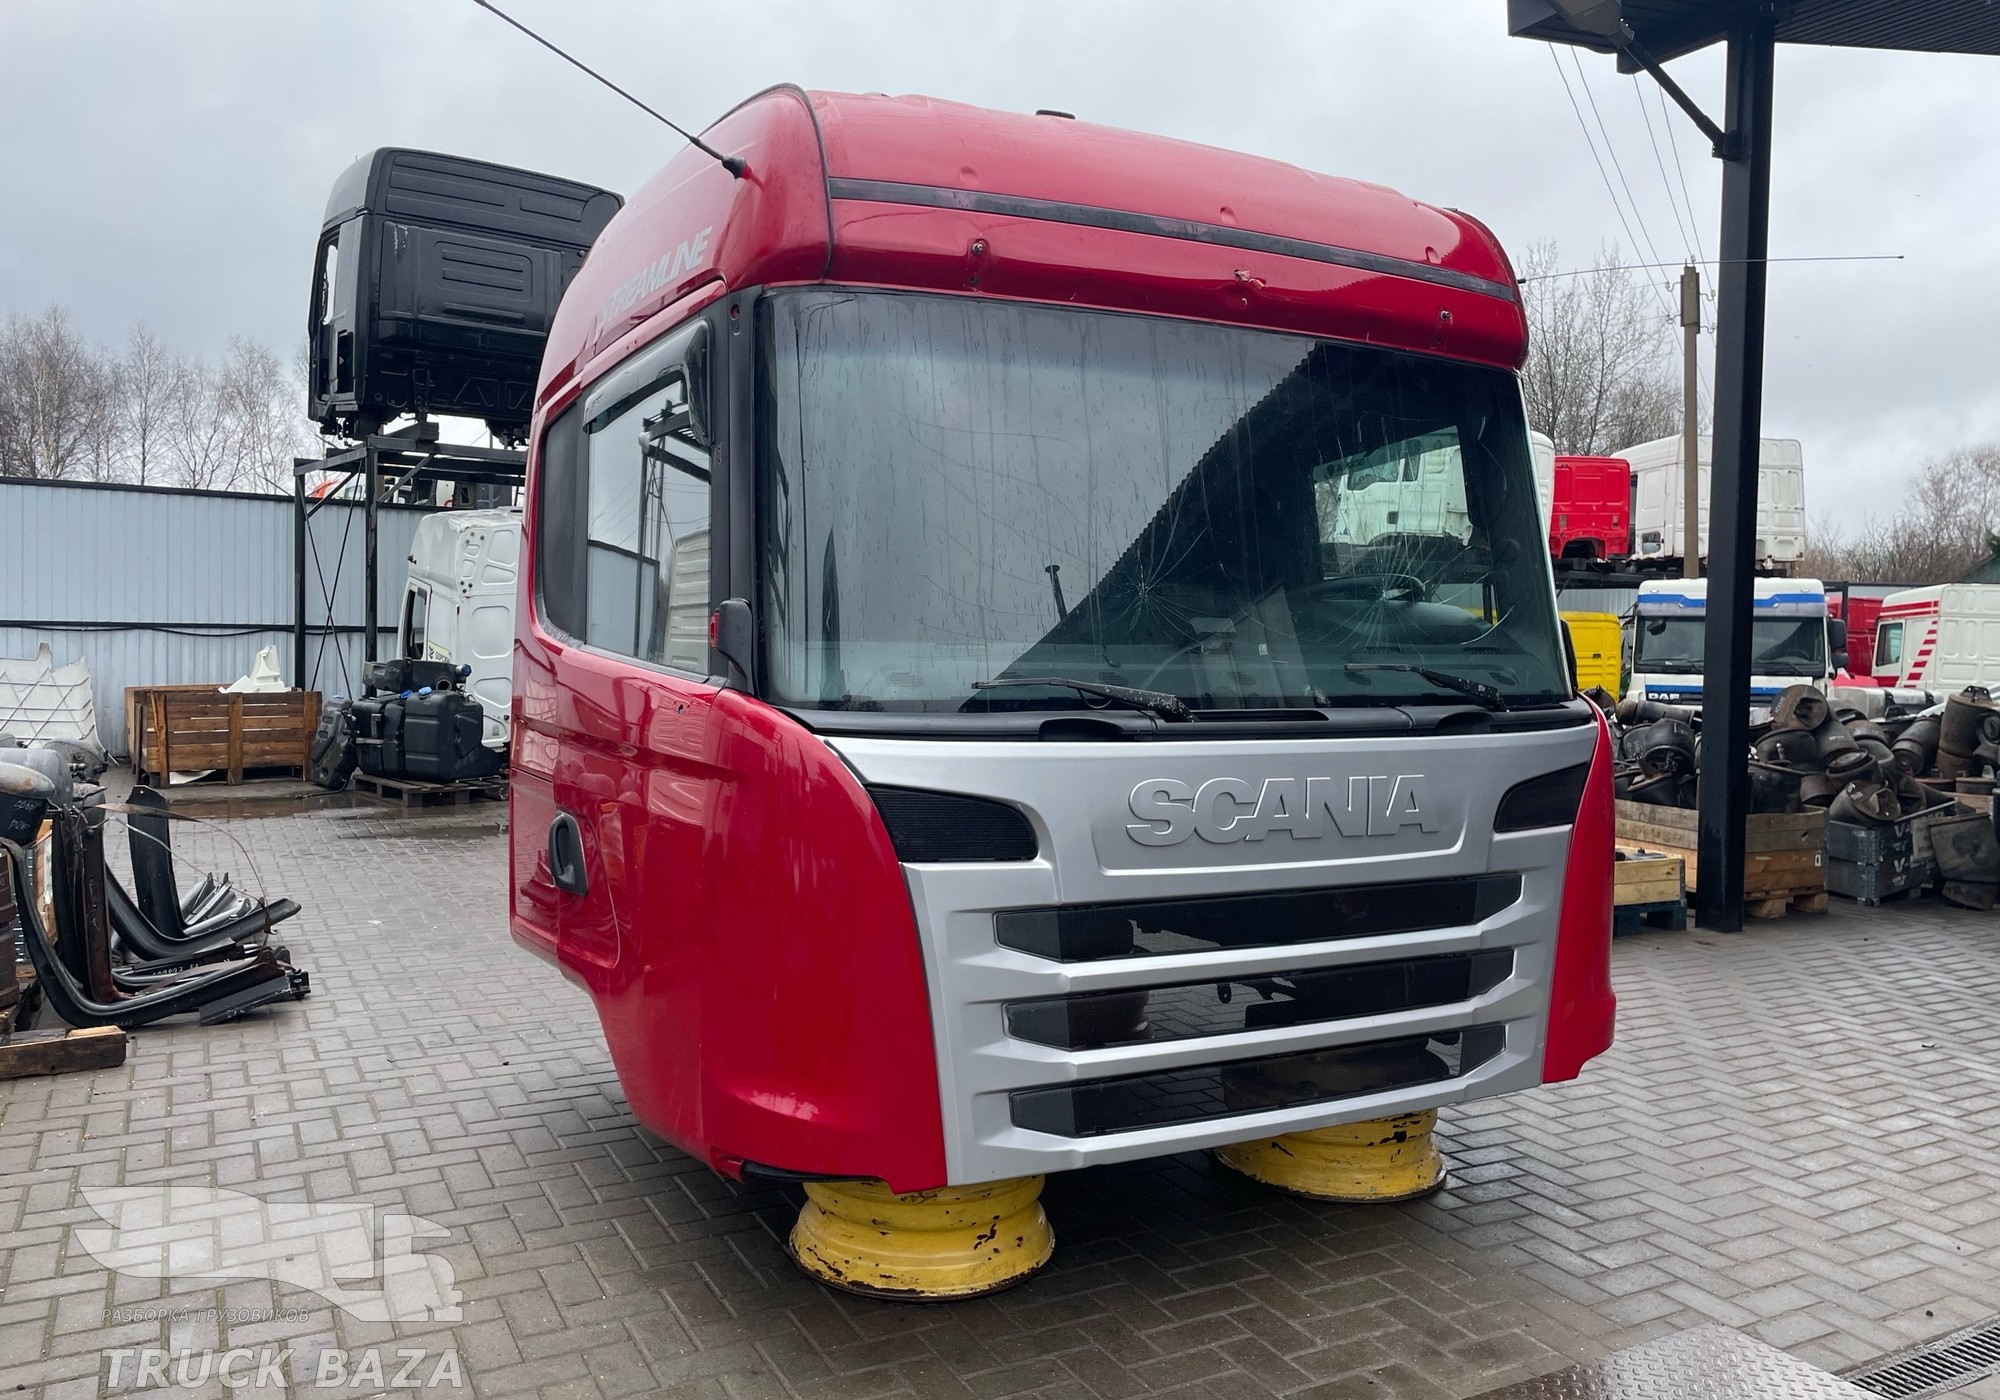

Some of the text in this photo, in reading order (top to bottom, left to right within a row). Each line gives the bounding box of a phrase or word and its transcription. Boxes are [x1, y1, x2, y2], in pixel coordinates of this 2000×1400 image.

[600, 226, 713, 325] STREAMLINE
[1648, 692, 1680, 700] DAF
[1126, 774, 1440, 847] SCANIA
